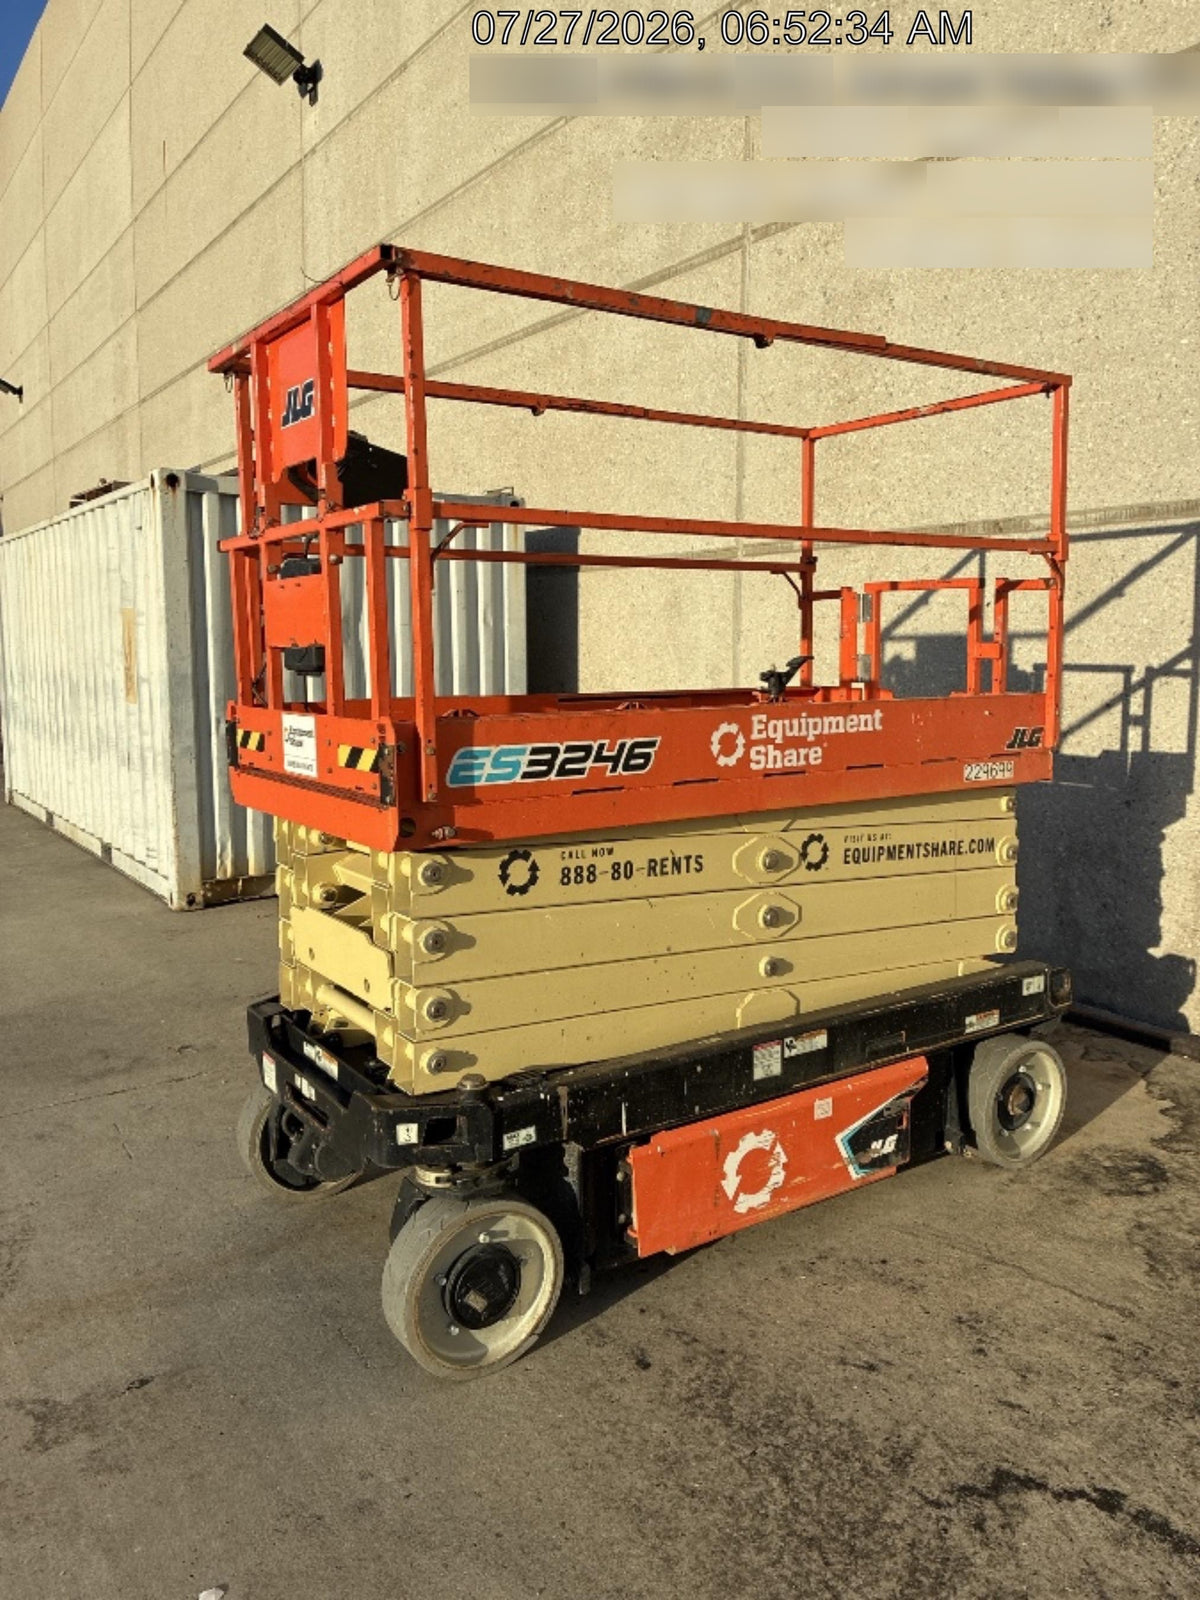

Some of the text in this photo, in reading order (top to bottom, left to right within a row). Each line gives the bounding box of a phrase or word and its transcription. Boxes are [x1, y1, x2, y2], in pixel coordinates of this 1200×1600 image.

[281, 379, 315, 429] JLG
[751, 709, 884, 743] Equipment
[1005, 727, 1045, 751] JLG
[446, 735, 662, 788] ES3246
[750, 743, 823, 771] Share
[560, 846, 615, 861] CALL NOW
[843, 837, 996, 865] EQUIPMENTSHARE.COM
[559, 854, 704, 886] 888-80-RENTS
